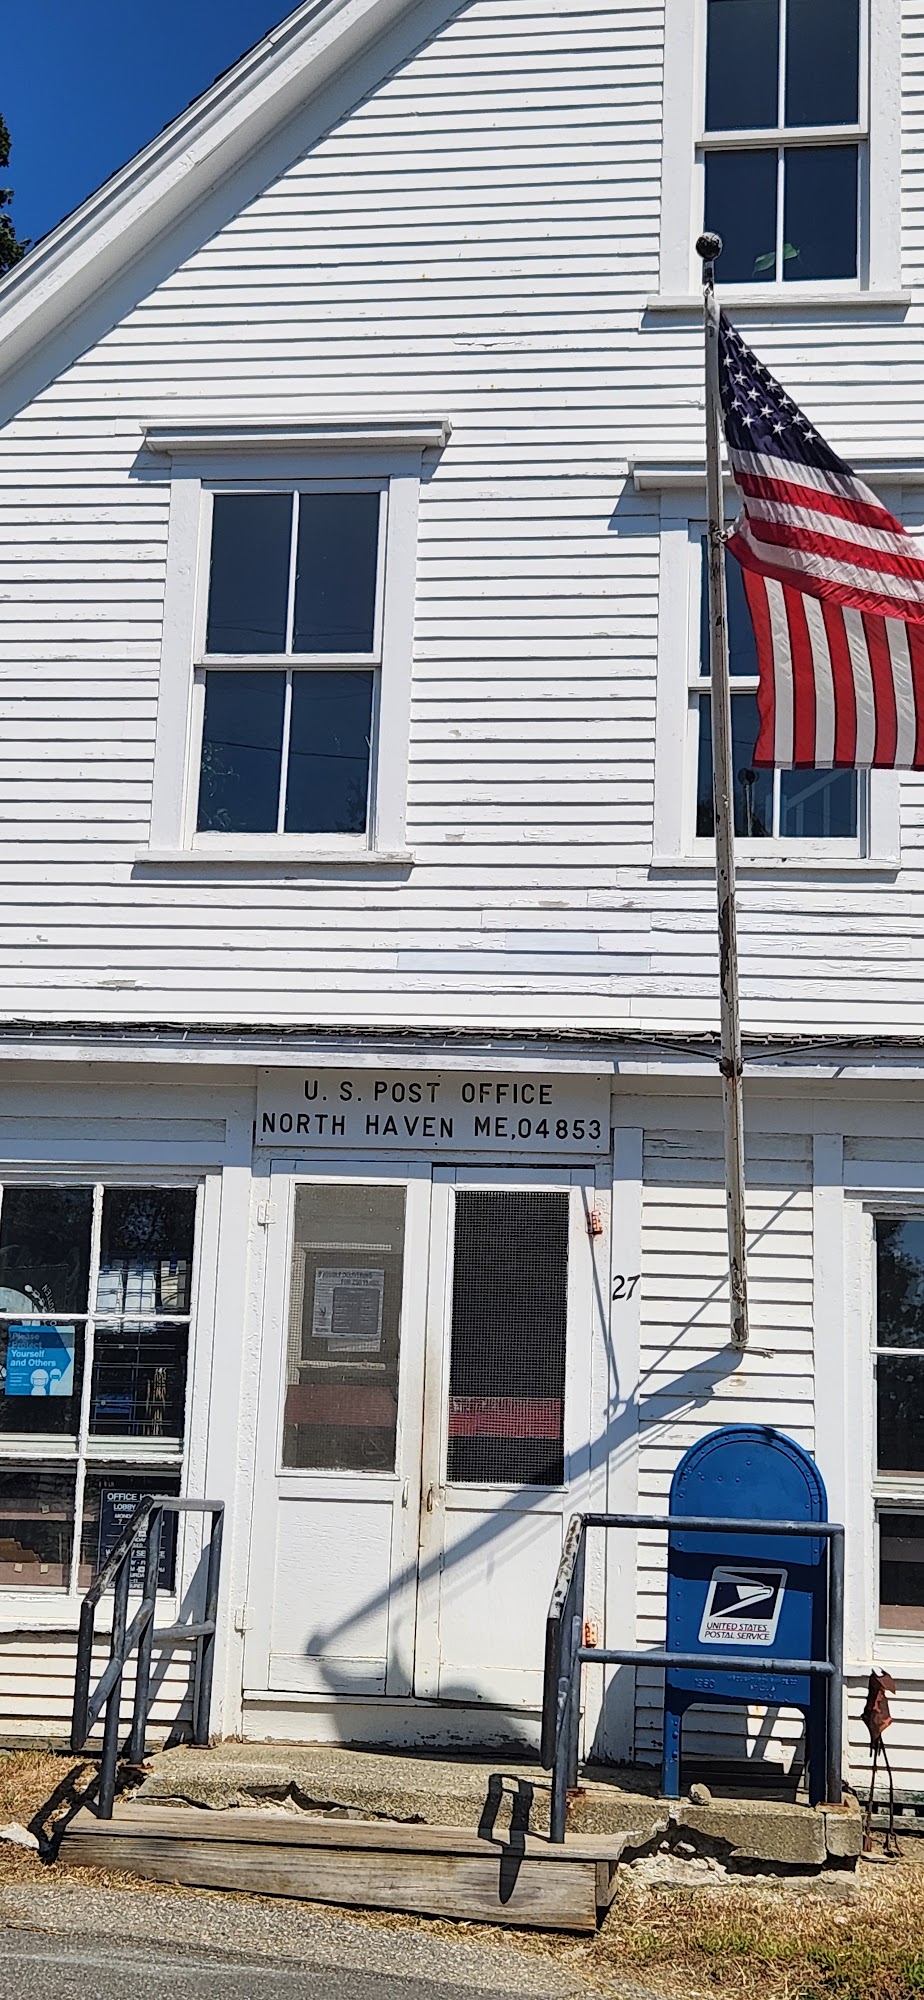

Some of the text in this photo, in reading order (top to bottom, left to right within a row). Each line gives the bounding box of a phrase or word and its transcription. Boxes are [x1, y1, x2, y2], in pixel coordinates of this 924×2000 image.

[374, 1080, 441, 1104] POST
[461, 1082, 553, 1105] OFFICE
[262, 1112, 346, 1136] NORTH
[365, 1114, 453, 1139] HAVEN
[612, 1274, 641, 1301] 27
[11, 1332, 40, 1341] Please
[11, 1341, 43, 1349] Protect
[11, 1349, 45, 1358] Yourself
[10, 1359, 56, 1367] and Others
[107, 1492, 138, 1501] OFFICE
[113, 1503, 136, 1511] LOBBY
[706, 1622, 768, 1632] UNITED STATES
[704, 1630, 770, 1641] POSTAL SERVICE
